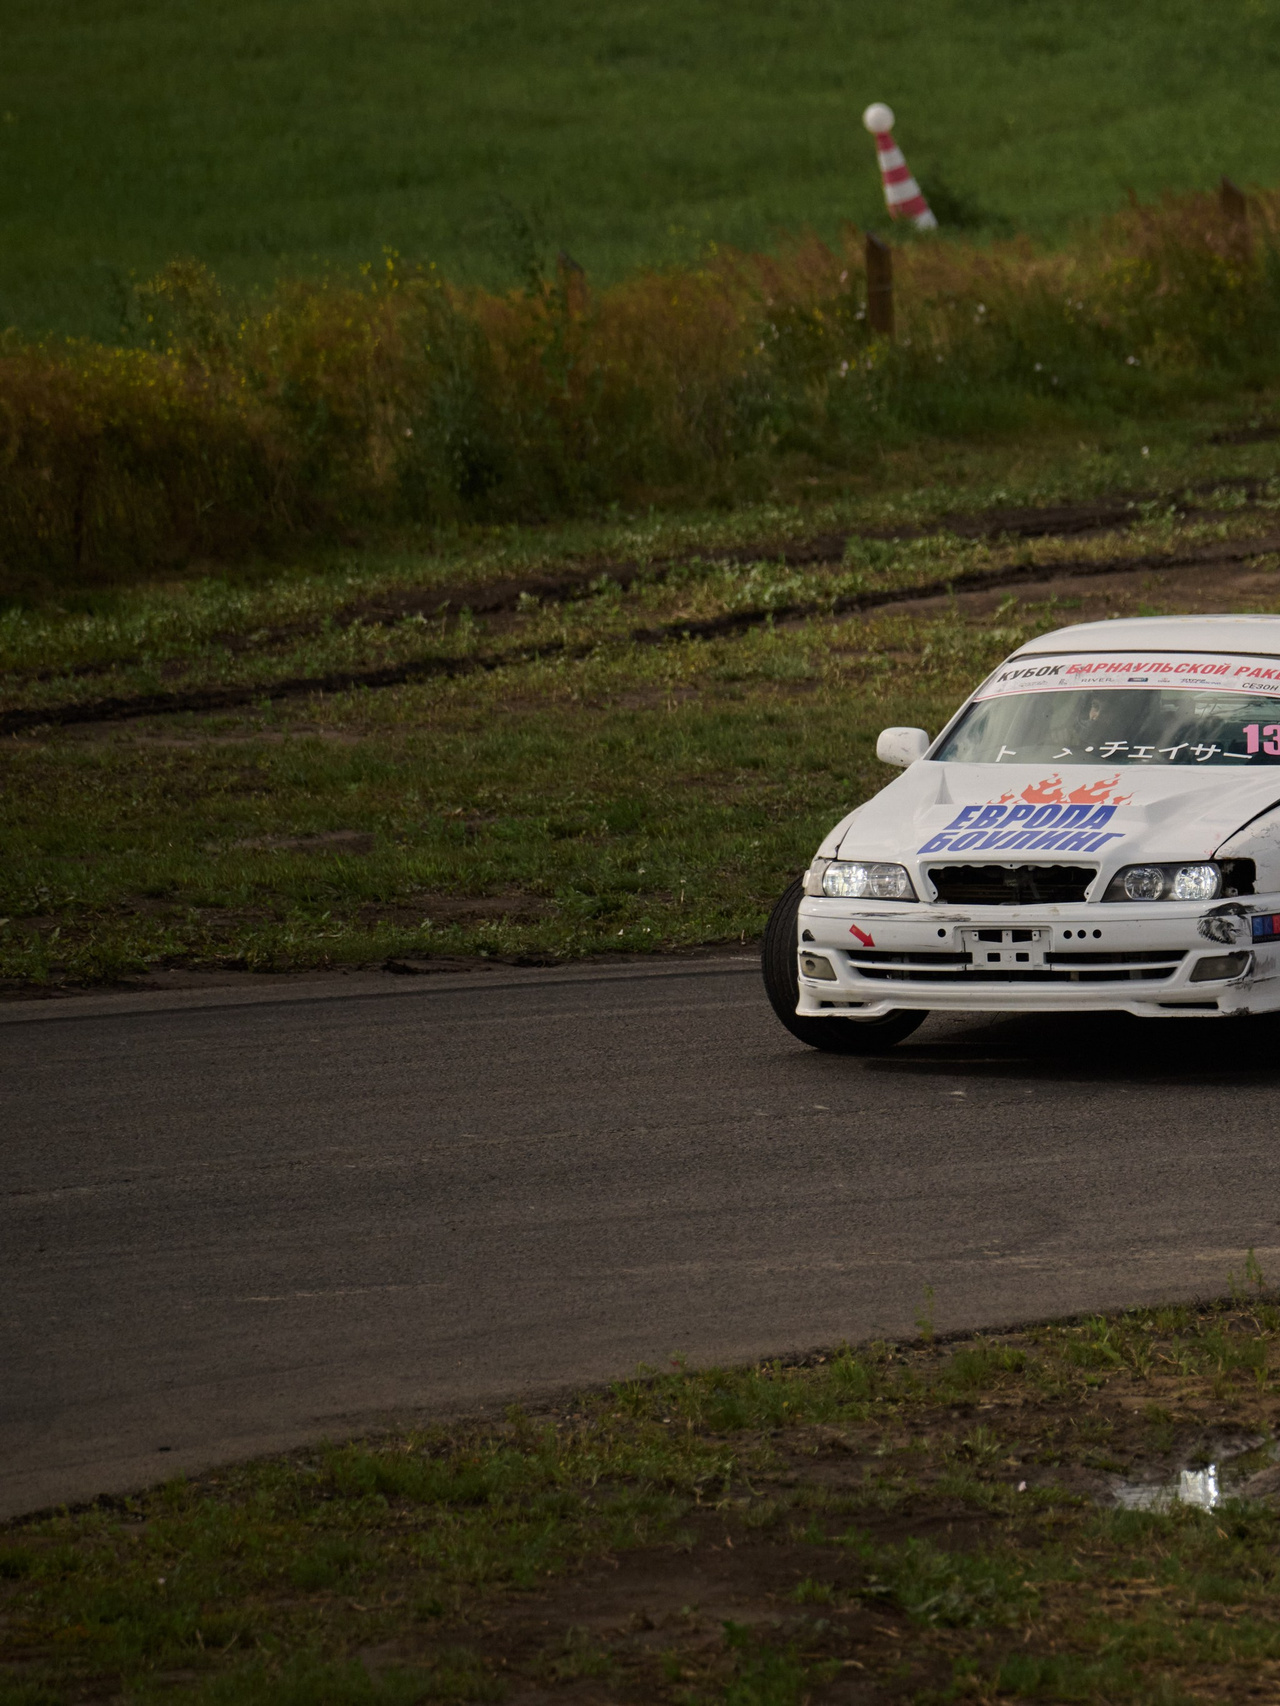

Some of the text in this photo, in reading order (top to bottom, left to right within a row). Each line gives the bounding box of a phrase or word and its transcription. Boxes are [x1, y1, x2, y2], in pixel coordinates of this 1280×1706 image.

[997, 664, 1066, 683] КУБОК
[1065, 662, 1232, 676] БАРНАУЛЬСКОЙ
[1242, 682, 1279, 692] СЕЗОН
[943, 804, 1118, 831] ЕВРОПА
[916, 830, 1126, 855] БОУЛИНГ
